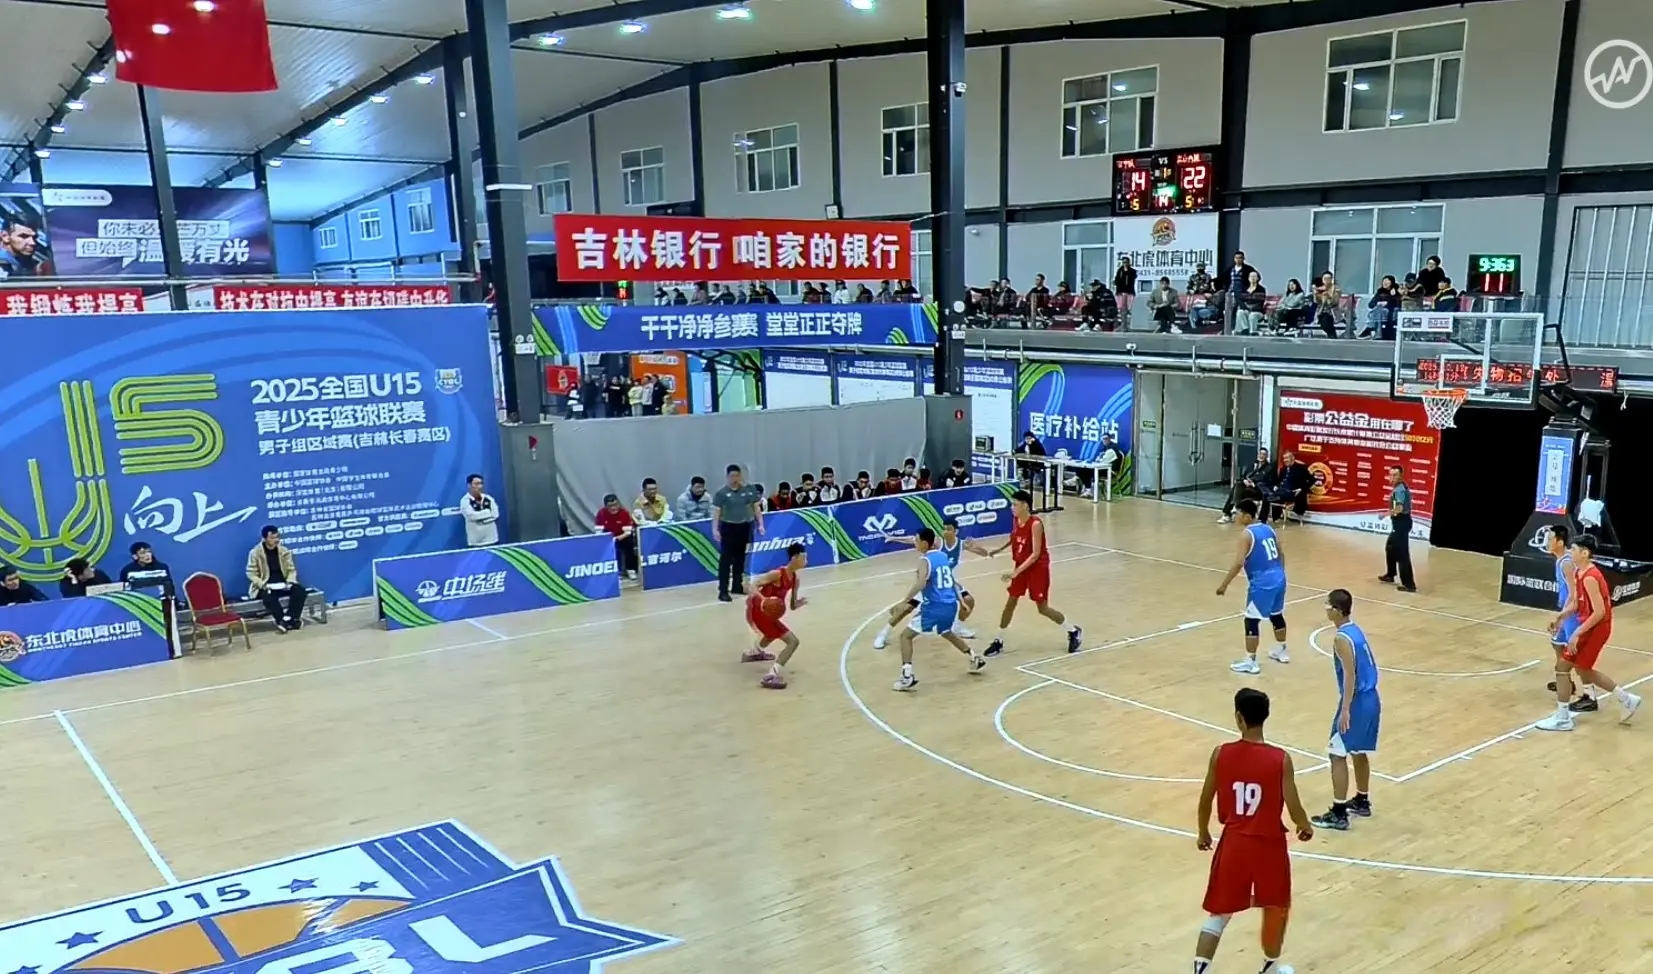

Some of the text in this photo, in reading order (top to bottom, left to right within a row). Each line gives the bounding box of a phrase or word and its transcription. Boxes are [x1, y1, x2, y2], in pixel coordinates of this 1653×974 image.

[1131, 172, 1146, 190] 14
[1184, 166, 1206, 189] 22
[571, 228, 901, 270] 吉林银行 咱家的银行
[641, 311, 863, 340] 干干净净参赛 堂堂正正夺牌
[250, 371, 423, 405] 2025全国U15
[255, 401, 427, 435] 青少年篮球联赛
[123, 485, 258, 543] 向上
[1262, 537, 1278, 560] 19
[936, 565, 953, 589] 13
[25, 621, 142, 649] 东北虎体育中心
[1232, 781, 1262, 816] 19
[124, 883, 251, 924] U15
